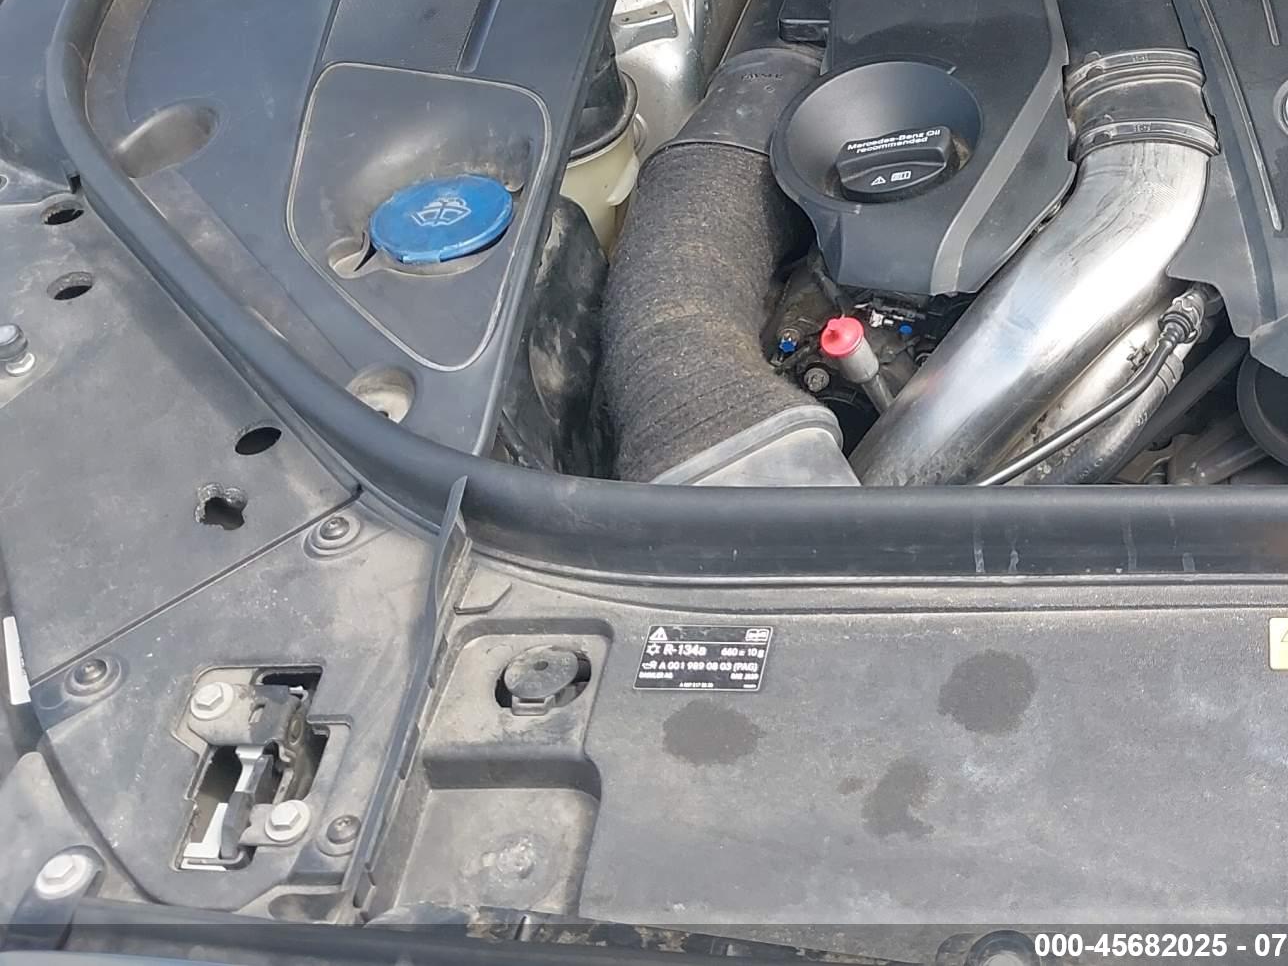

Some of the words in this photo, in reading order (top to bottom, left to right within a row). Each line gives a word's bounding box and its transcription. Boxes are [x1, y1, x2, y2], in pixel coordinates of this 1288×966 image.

[847, 132, 925, 150] Mercedes-Benz
[926, 129, 941, 137] Oil
[856, 136, 929, 154] recommended
[663, 644, 707, 656] R-134a
[748, 648, 757, 657] 10
[658, 661, 666, 670] A
[687, 661, 705, 671] 989
[720, 661, 732, 671] 03
[733, 662, 758, 673] (PAG)
